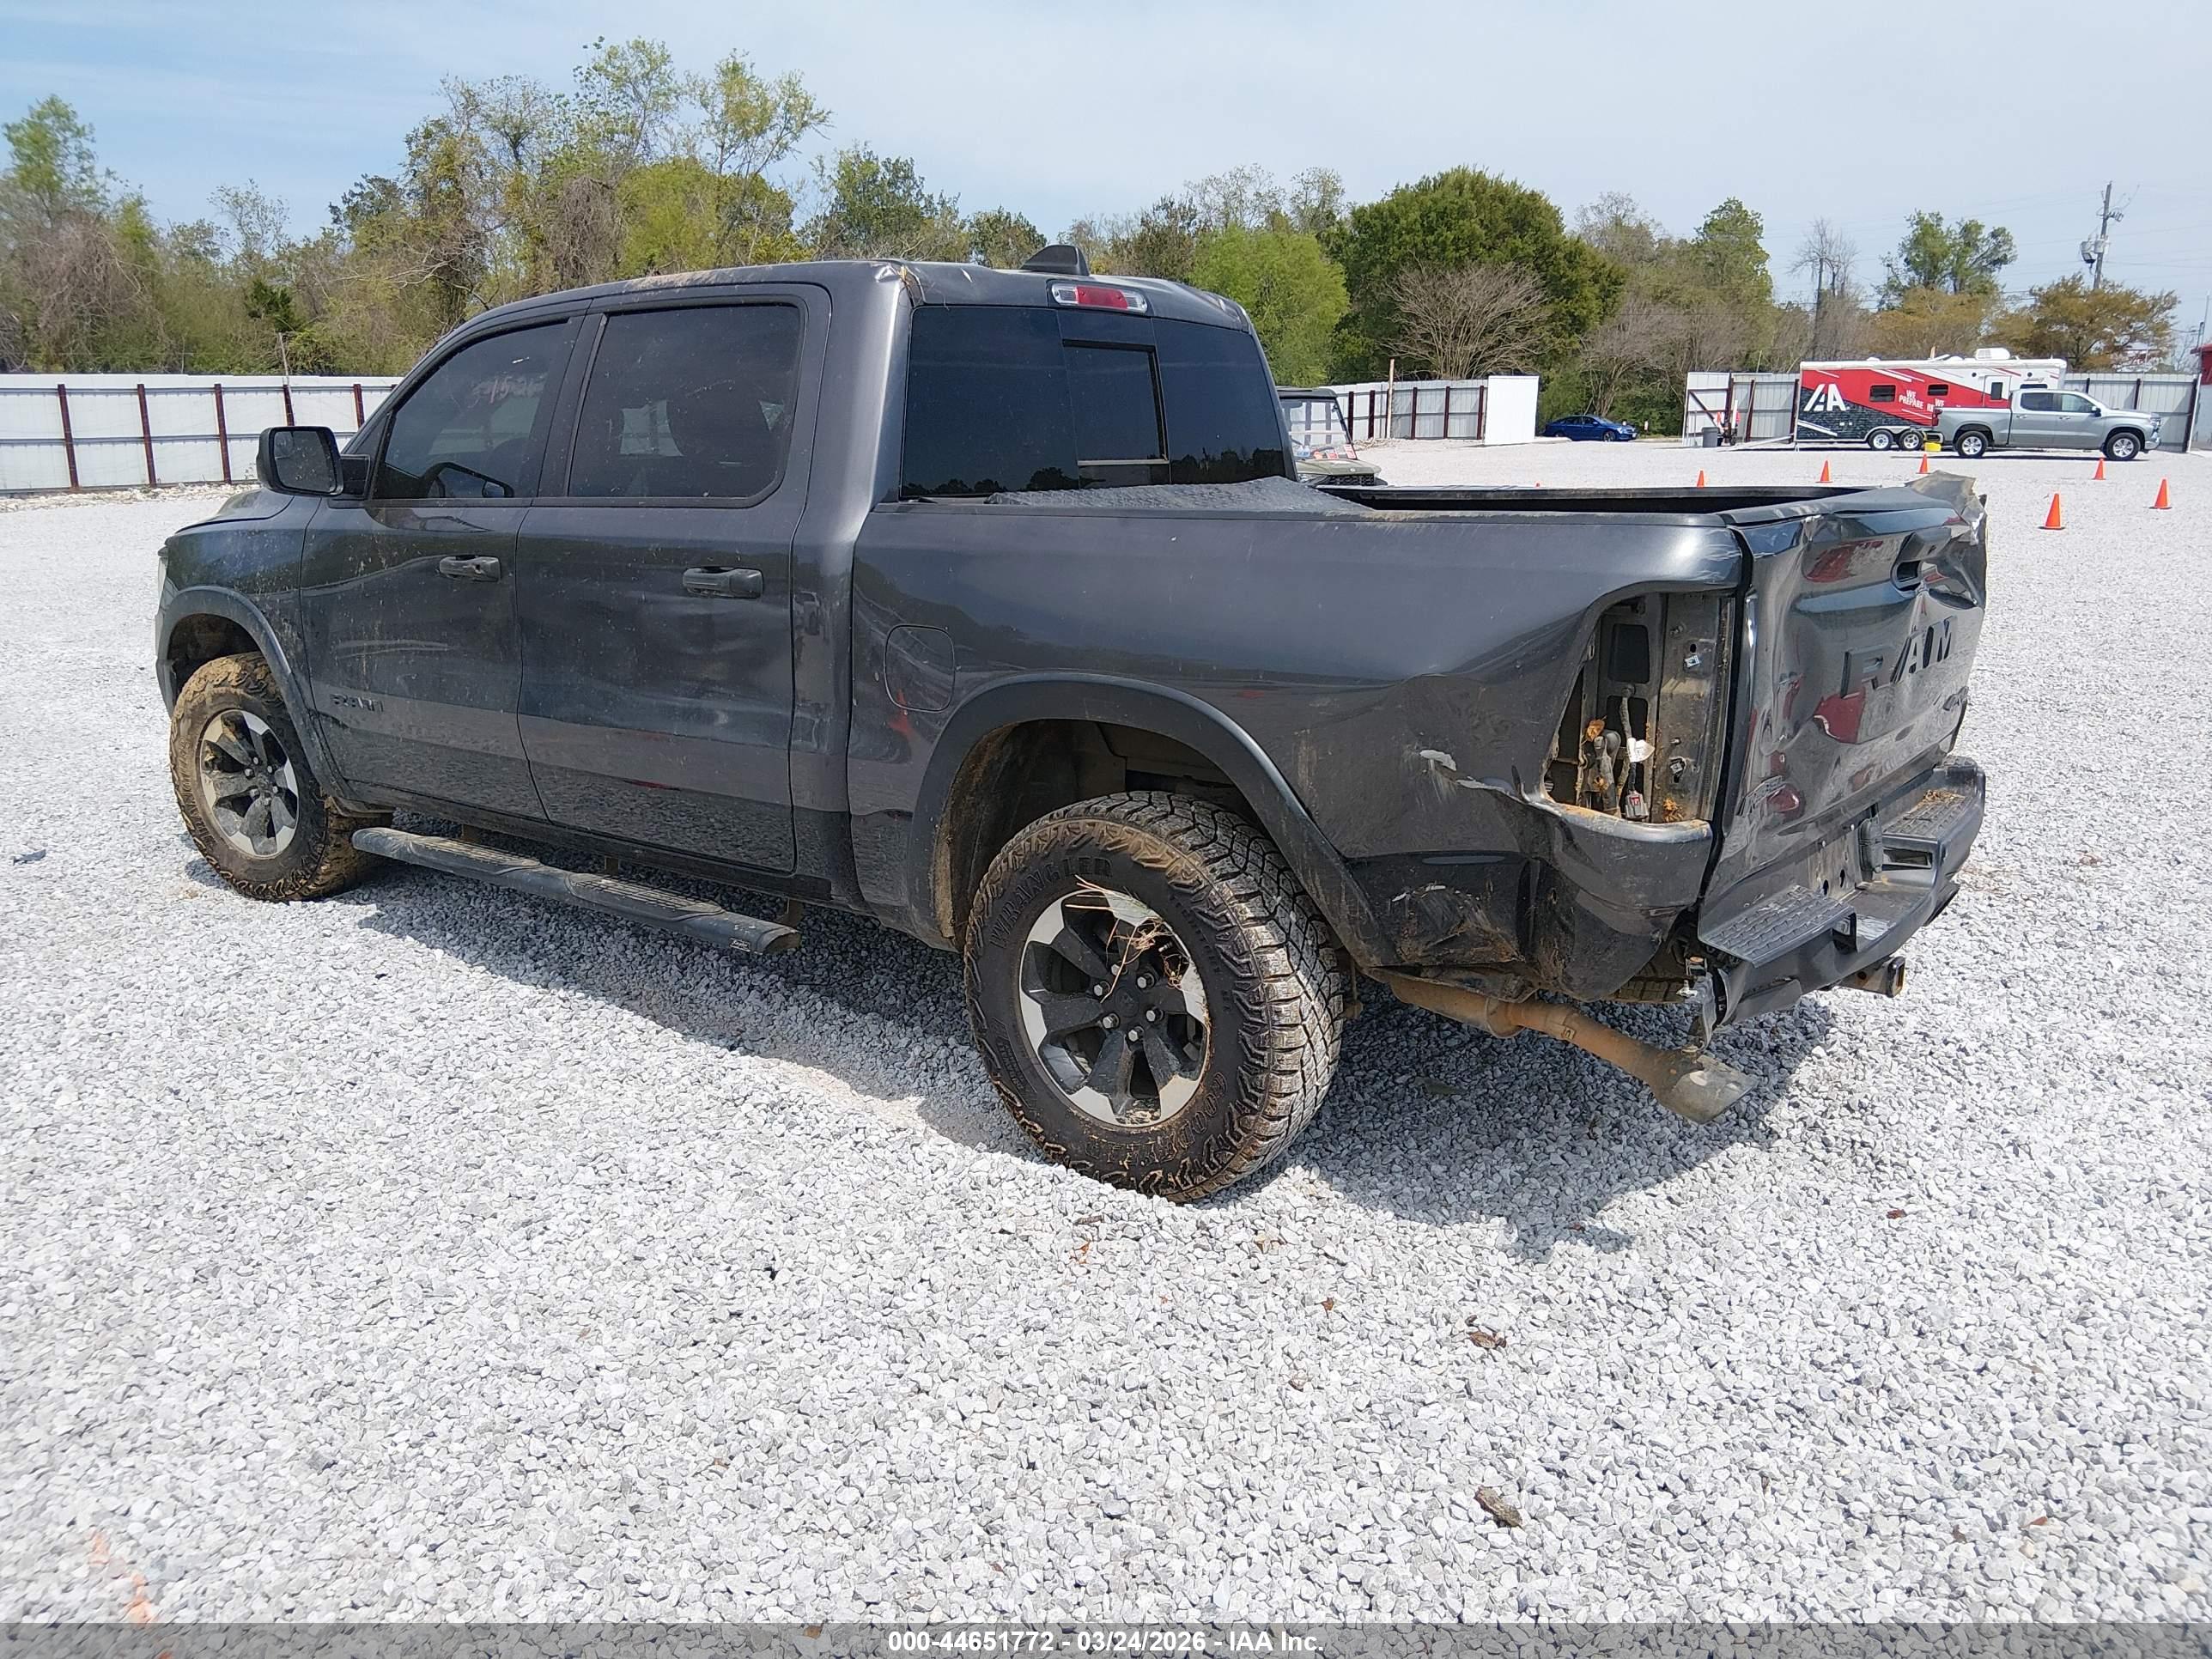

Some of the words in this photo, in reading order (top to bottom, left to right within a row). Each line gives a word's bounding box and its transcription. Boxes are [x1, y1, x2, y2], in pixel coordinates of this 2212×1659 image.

[1899, 394, 1924, 410] PREPARE
[1905, 389, 1917, 399] WE
[1839, 615, 1957, 700] RAM
[988, 855, 1114, 950] WRANGLER
